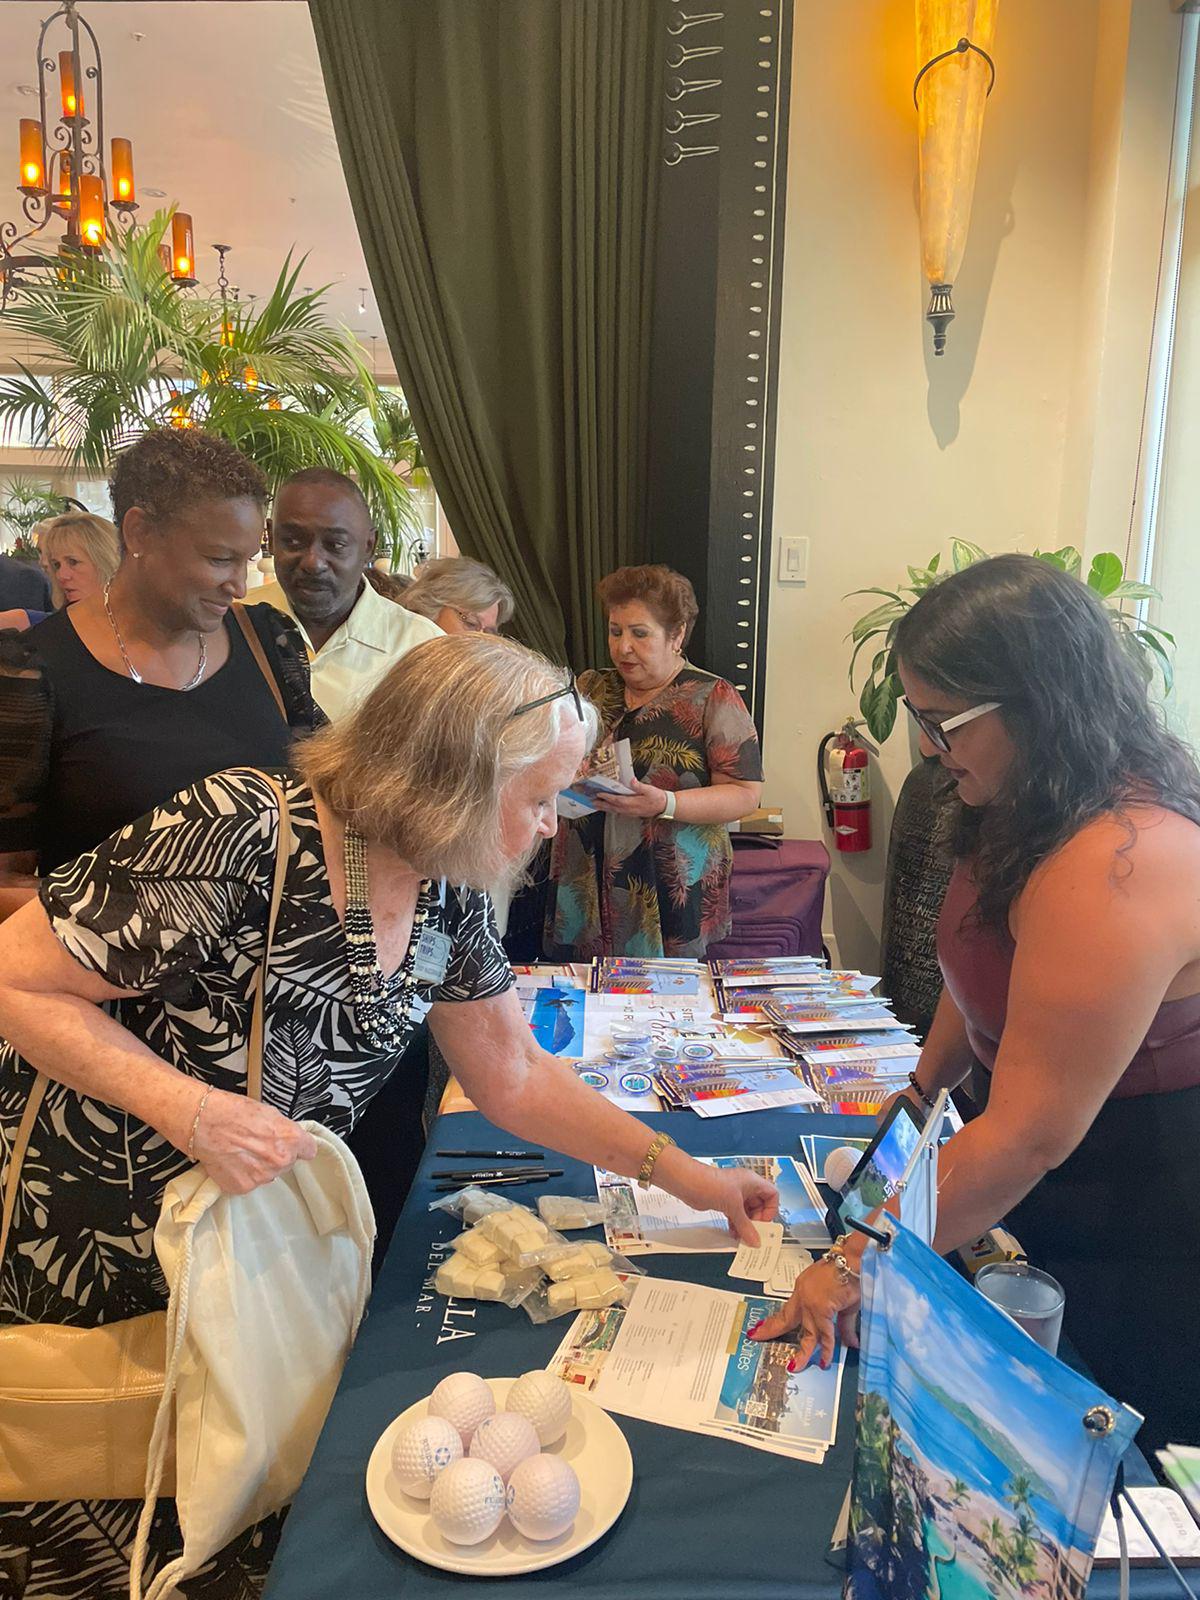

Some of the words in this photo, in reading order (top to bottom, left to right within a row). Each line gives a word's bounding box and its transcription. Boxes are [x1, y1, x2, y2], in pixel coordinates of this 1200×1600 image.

[427, 1242, 447, 1271] DEL
[415, 1278, 437, 1314] MAR
[737, 1339, 758, 1371] Suites
